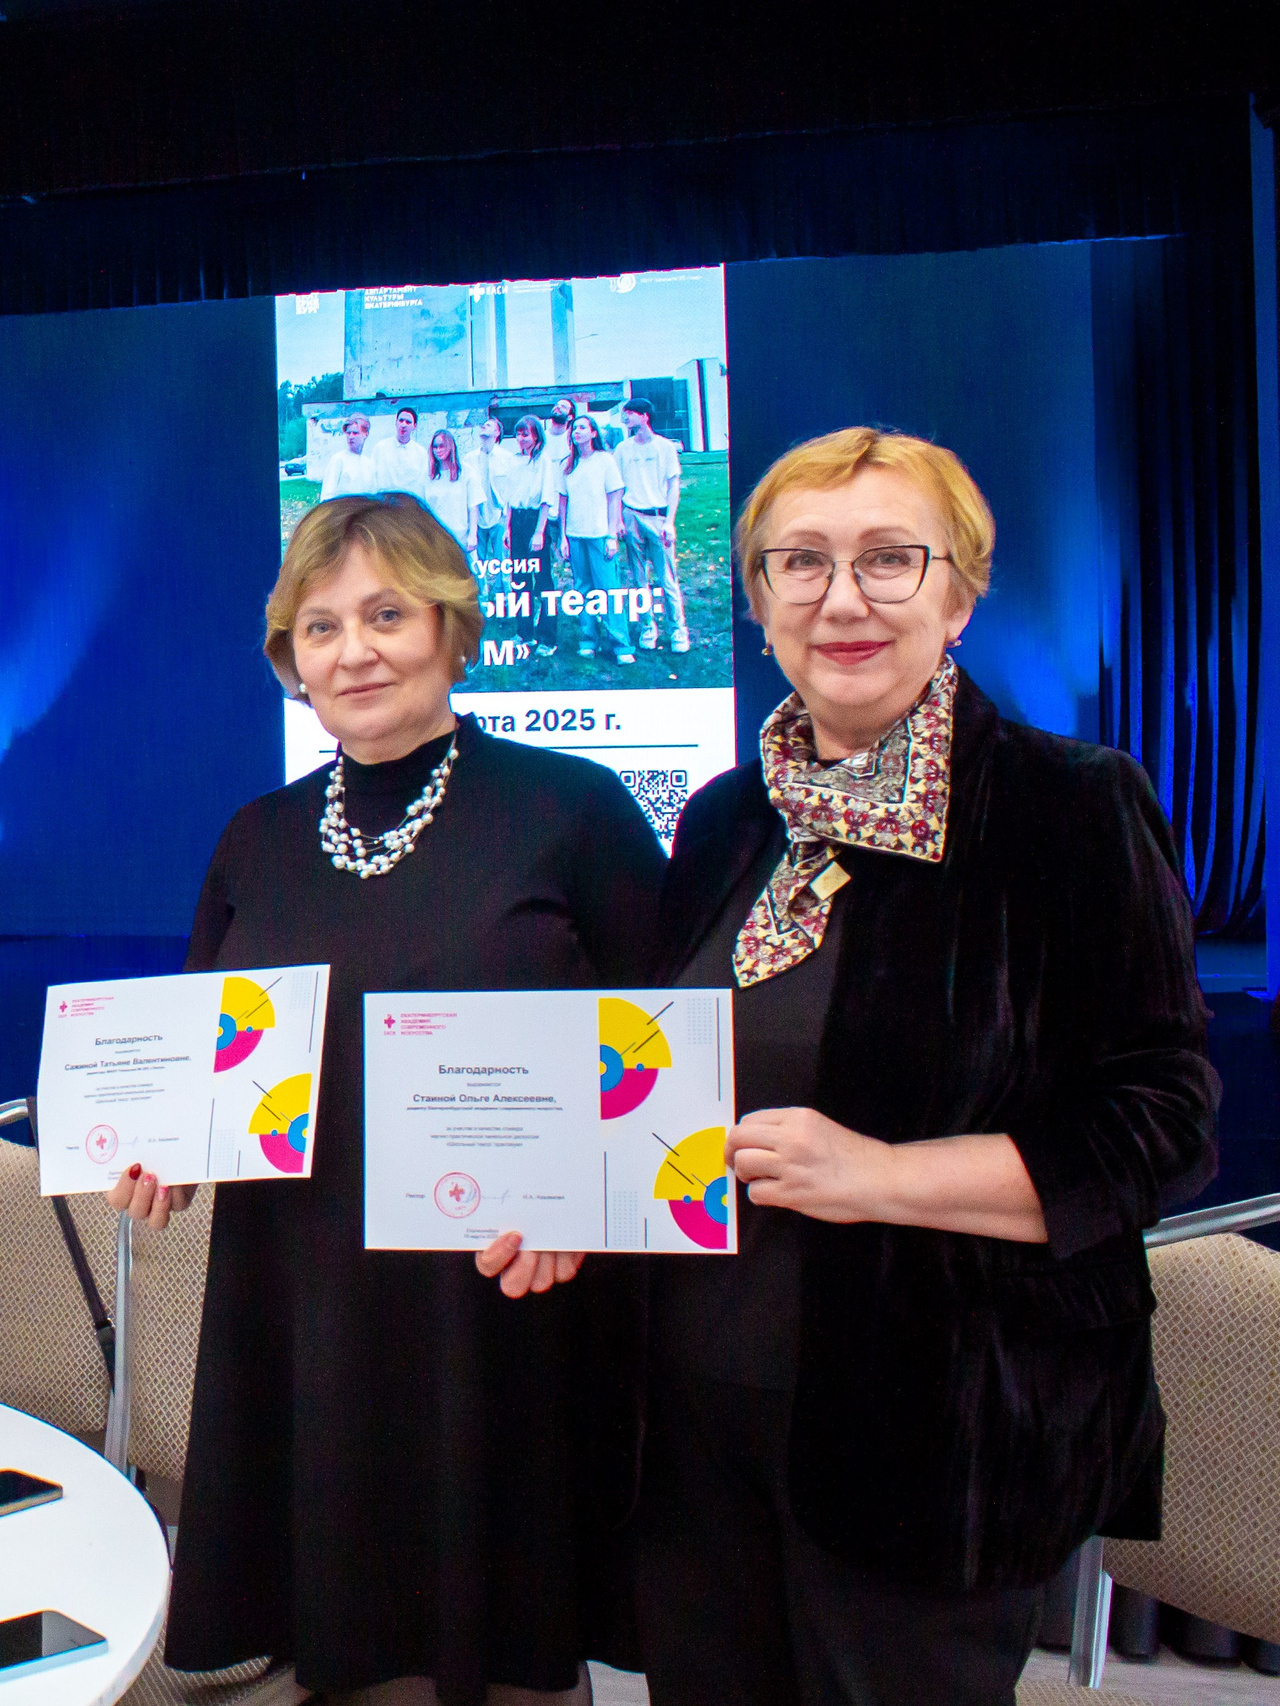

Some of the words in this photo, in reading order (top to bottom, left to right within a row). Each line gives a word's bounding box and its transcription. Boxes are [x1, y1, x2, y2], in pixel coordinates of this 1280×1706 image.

[364, 299, 423, 310] ЕКАТЕРИНБУРГА
[541, 587, 664, 622] театр:
[525, 708, 596, 732] 2025
[605, 713, 621, 731] г.
[95, 1034, 163, 1046] Благодарность
[100, 1060, 131, 1068] Татьяне
[438, 1064, 529, 1076] Благодарность
[459, 1094, 490, 1104] Ольге
[493, 1094, 557, 1104] Алексеевне,
